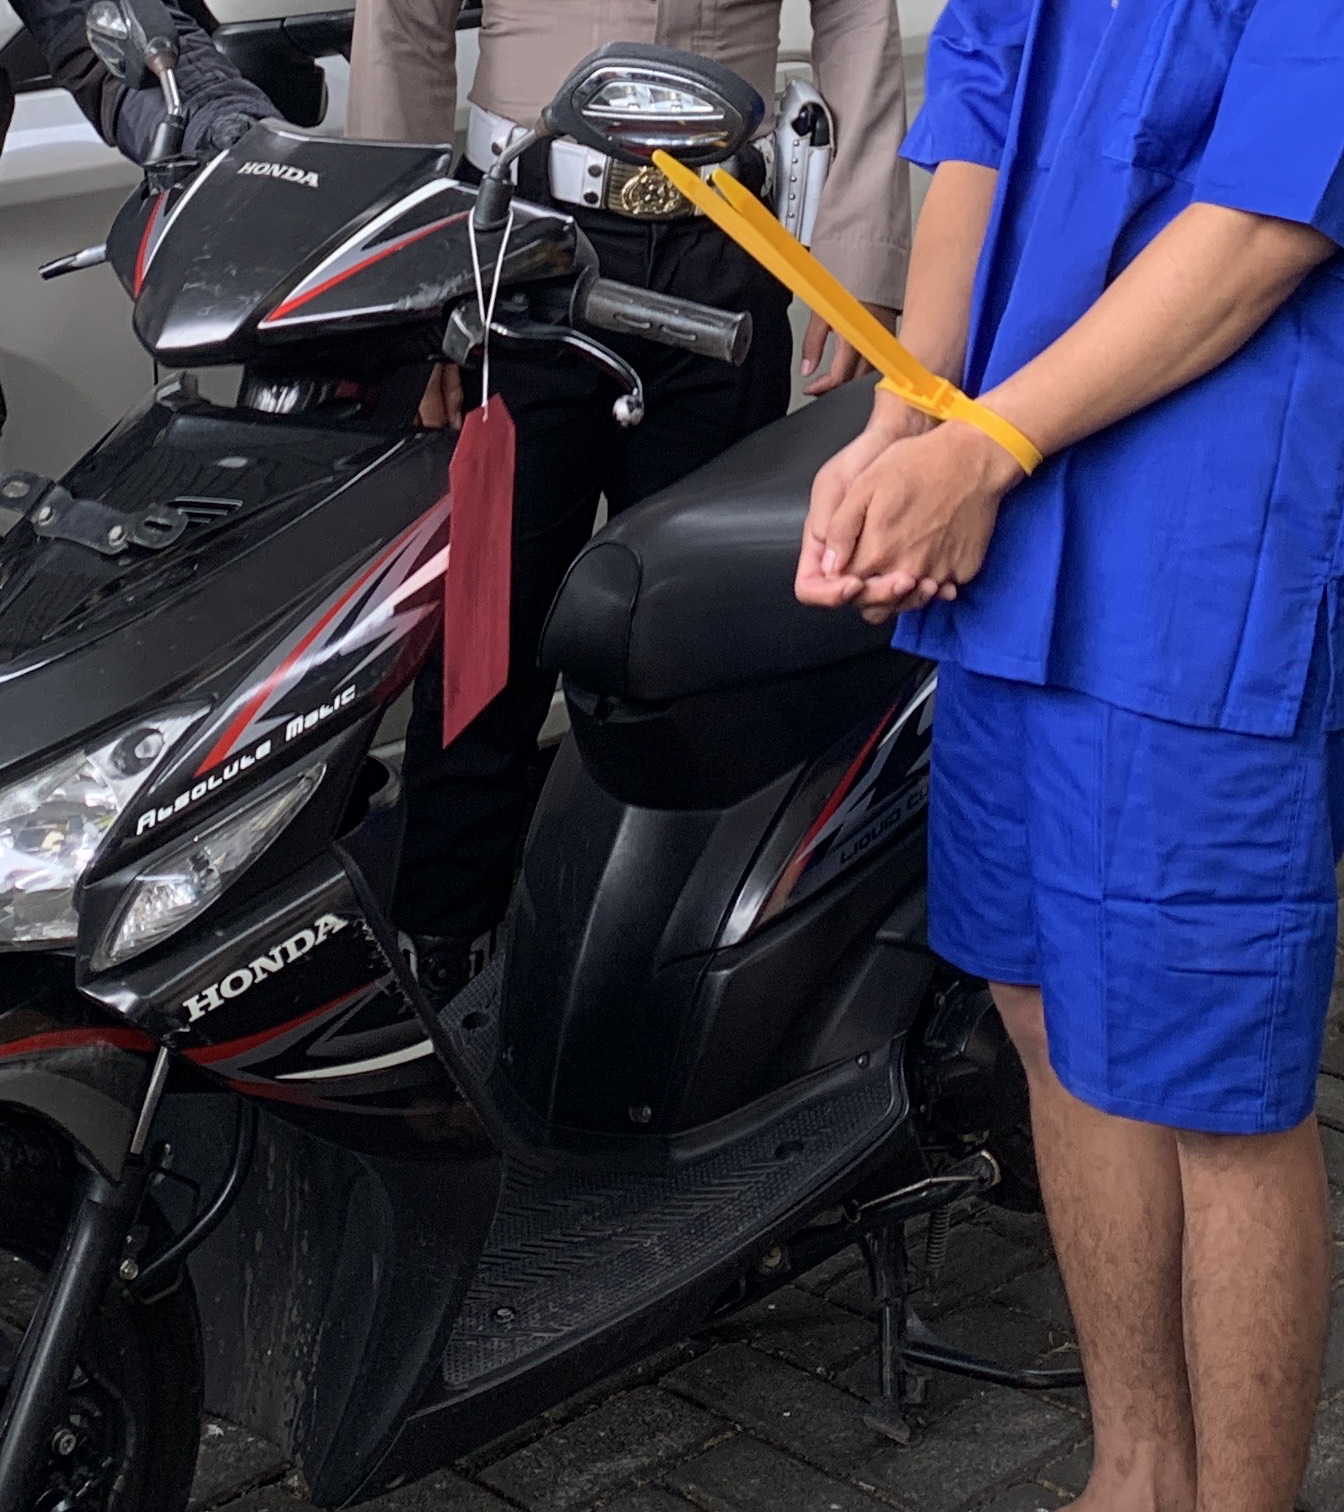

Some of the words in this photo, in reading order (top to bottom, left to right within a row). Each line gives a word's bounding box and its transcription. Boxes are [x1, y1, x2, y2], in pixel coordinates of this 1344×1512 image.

[236, 161, 319, 188] HONDA
[840, 809, 901, 864] LIQUID
[182, 913, 348, 1023] HONDA
